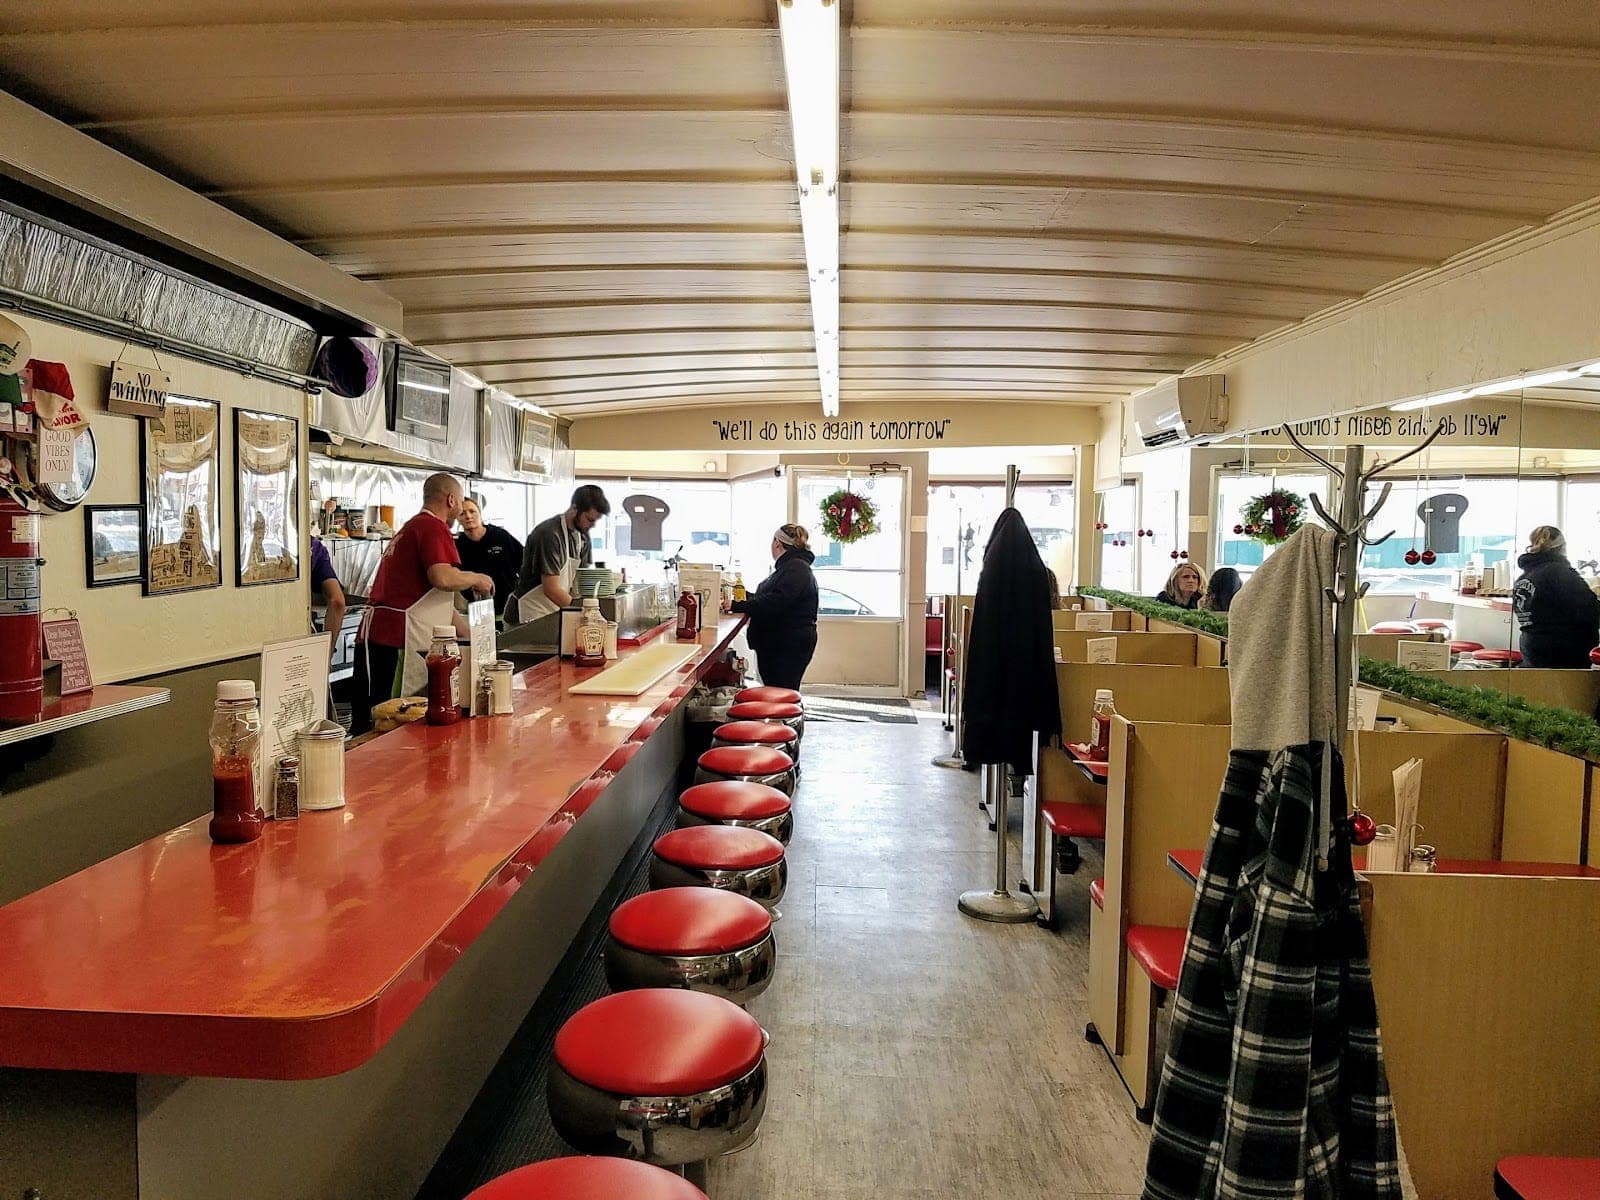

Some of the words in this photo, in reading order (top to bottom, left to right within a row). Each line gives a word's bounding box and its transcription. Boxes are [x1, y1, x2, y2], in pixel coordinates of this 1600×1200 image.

[135, 372, 151, 388] NO
[111, 380, 167, 411] WHINING
[45, 430, 71, 442] GOOD
[759, 421, 778, 440] do
[783, 420, 816, 440] this
[822, 420, 863, 440] again
[45, 445, 70, 457] VIBES
